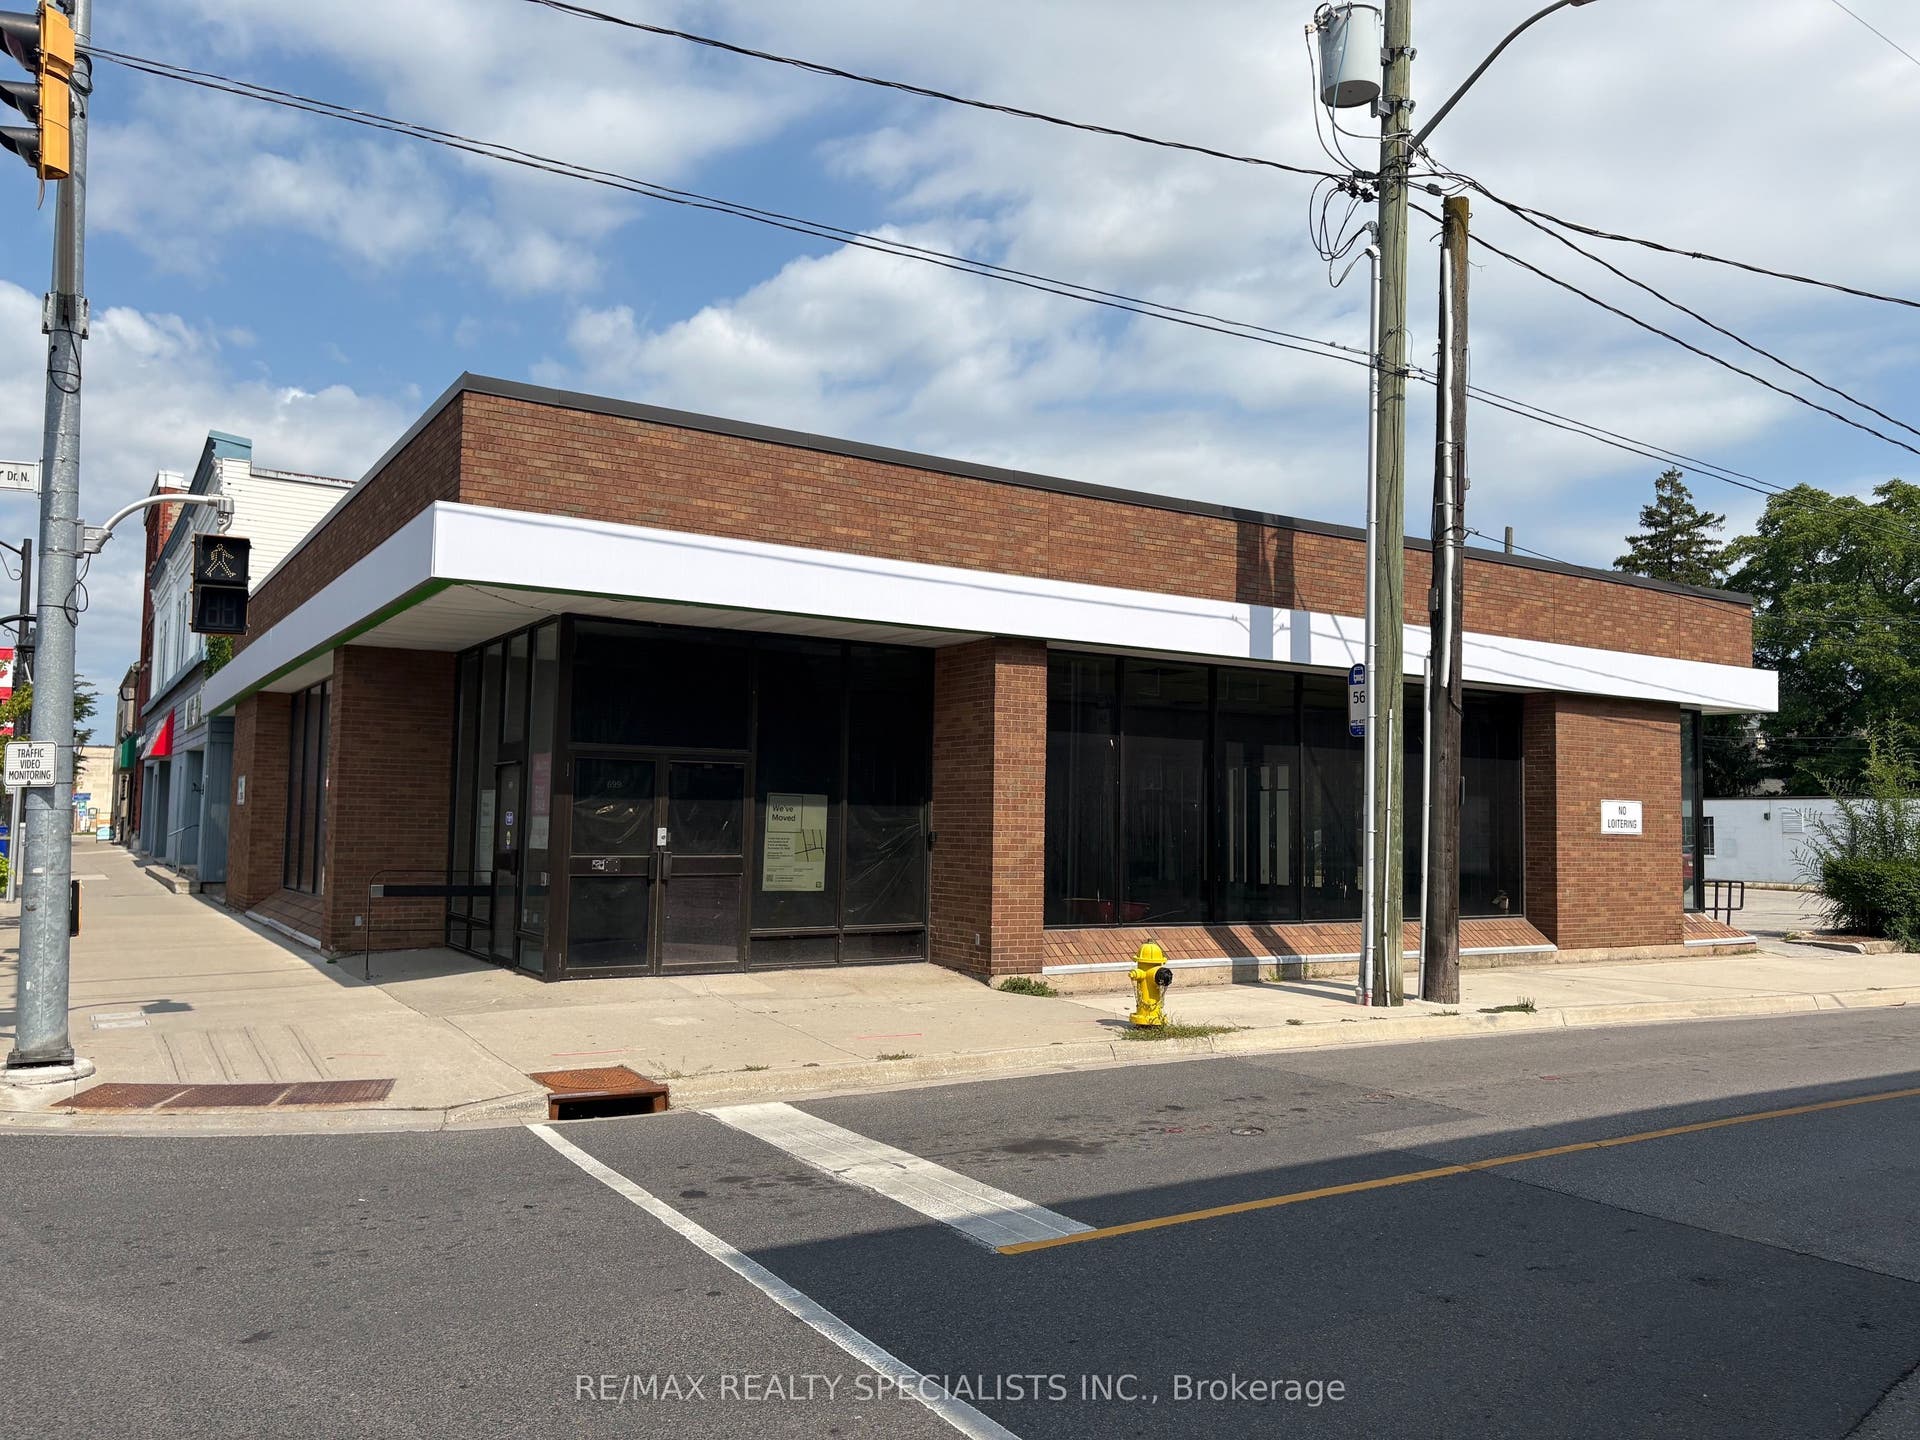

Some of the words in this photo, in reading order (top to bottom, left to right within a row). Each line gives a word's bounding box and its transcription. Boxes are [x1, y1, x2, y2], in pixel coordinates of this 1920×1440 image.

[7, 470, 18, 481] Dr.
[20, 472, 30, 482] N.
[1353, 691, 1366, 704] 56
[17, 748, 44, 758] TRAFFIC
[20, 759, 41, 769] VIDEO
[8, 770, 51, 780] MONITORING
[1618, 805, 1627, 815] NO
[771, 814, 796, 822] Moved
[1607, 818, 1637, 828] LOITERING
